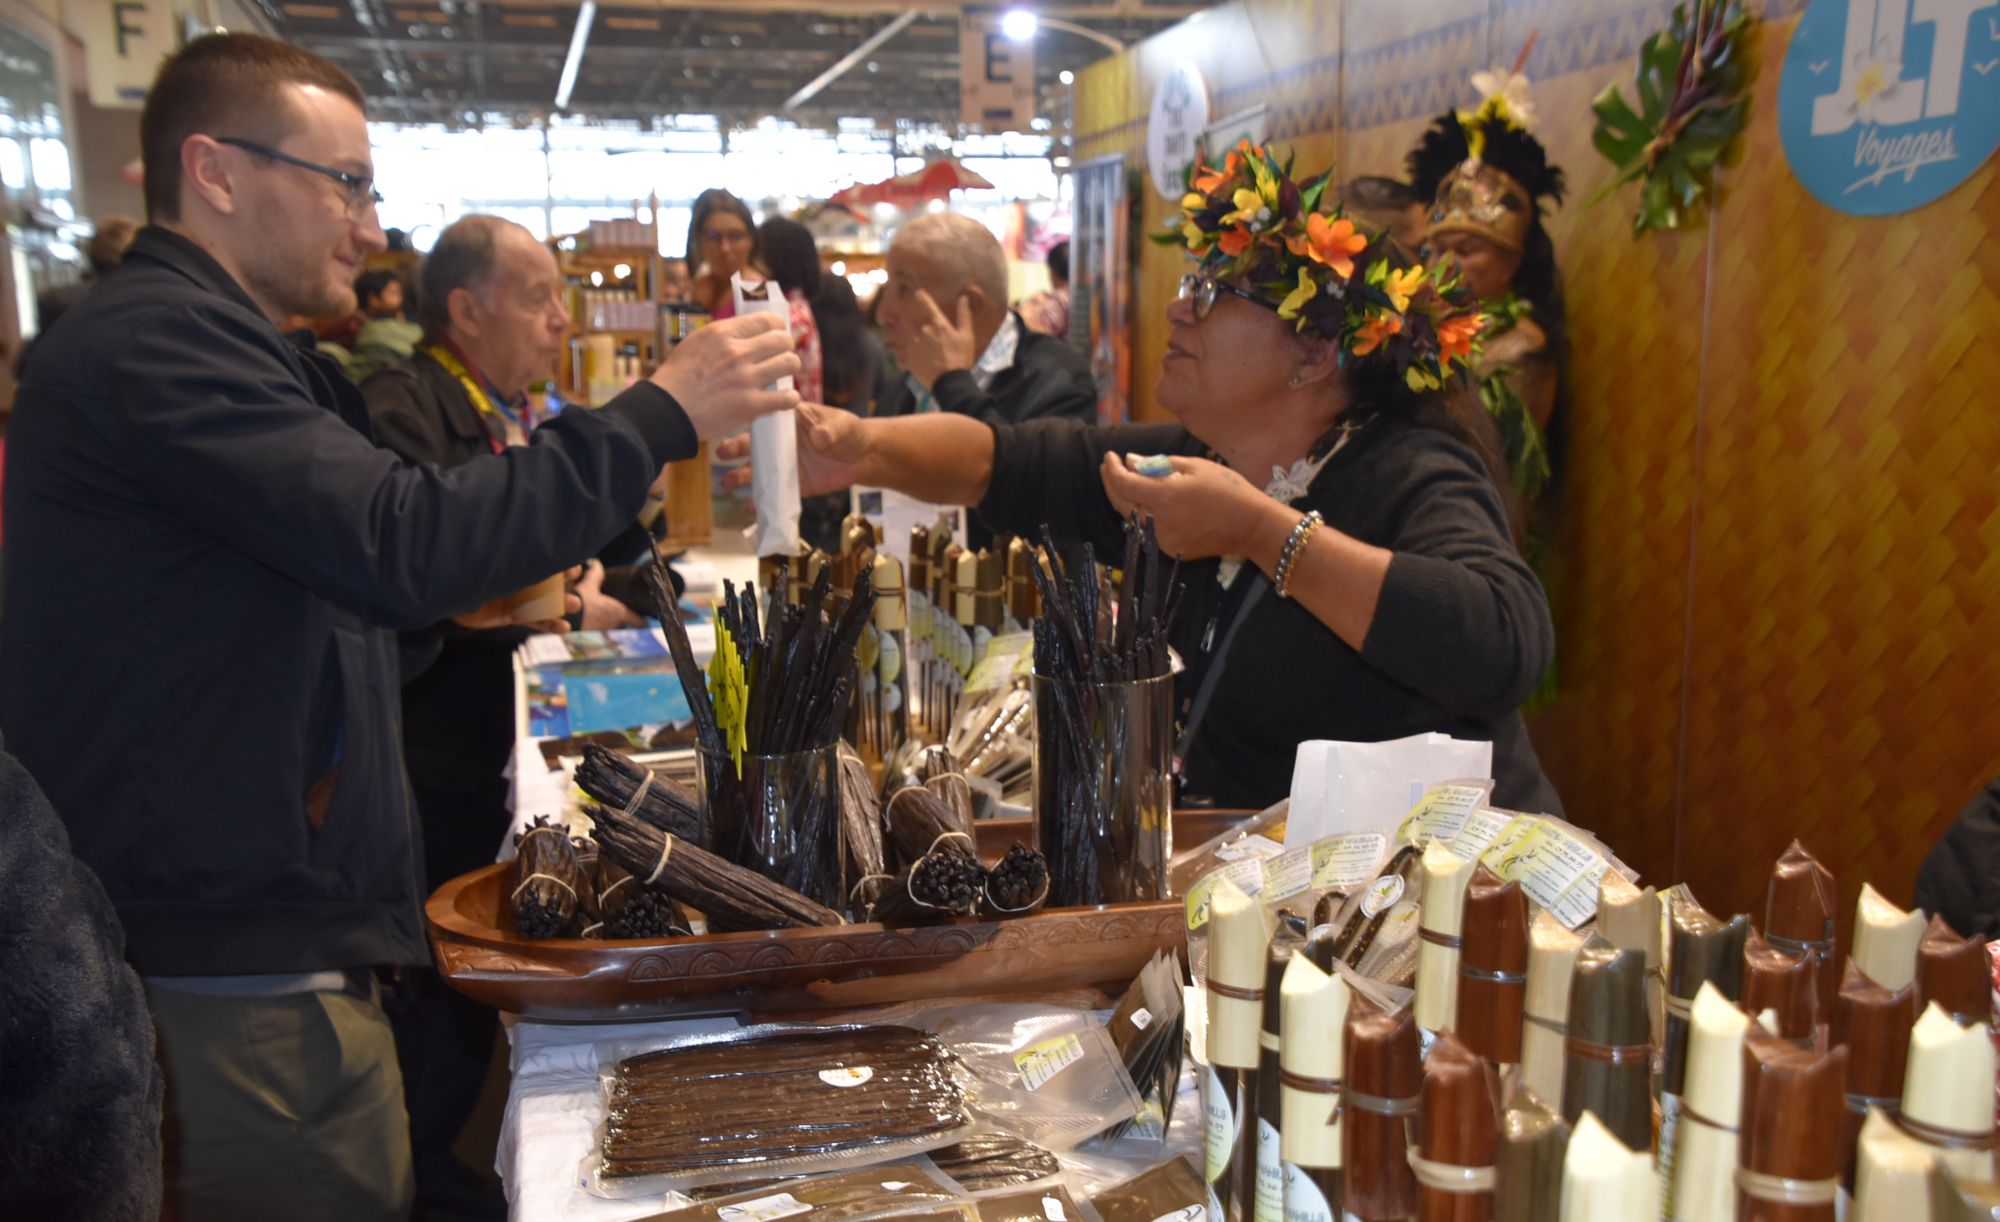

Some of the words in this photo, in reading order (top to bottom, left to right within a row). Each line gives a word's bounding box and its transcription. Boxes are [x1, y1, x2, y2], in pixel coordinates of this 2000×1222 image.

[114, 2, 146, 56] F
[985, 32, 1012, 82] E
[1811, 0, 1999, 136] JLT
[1852, 126, 1955, 186] Voyages
